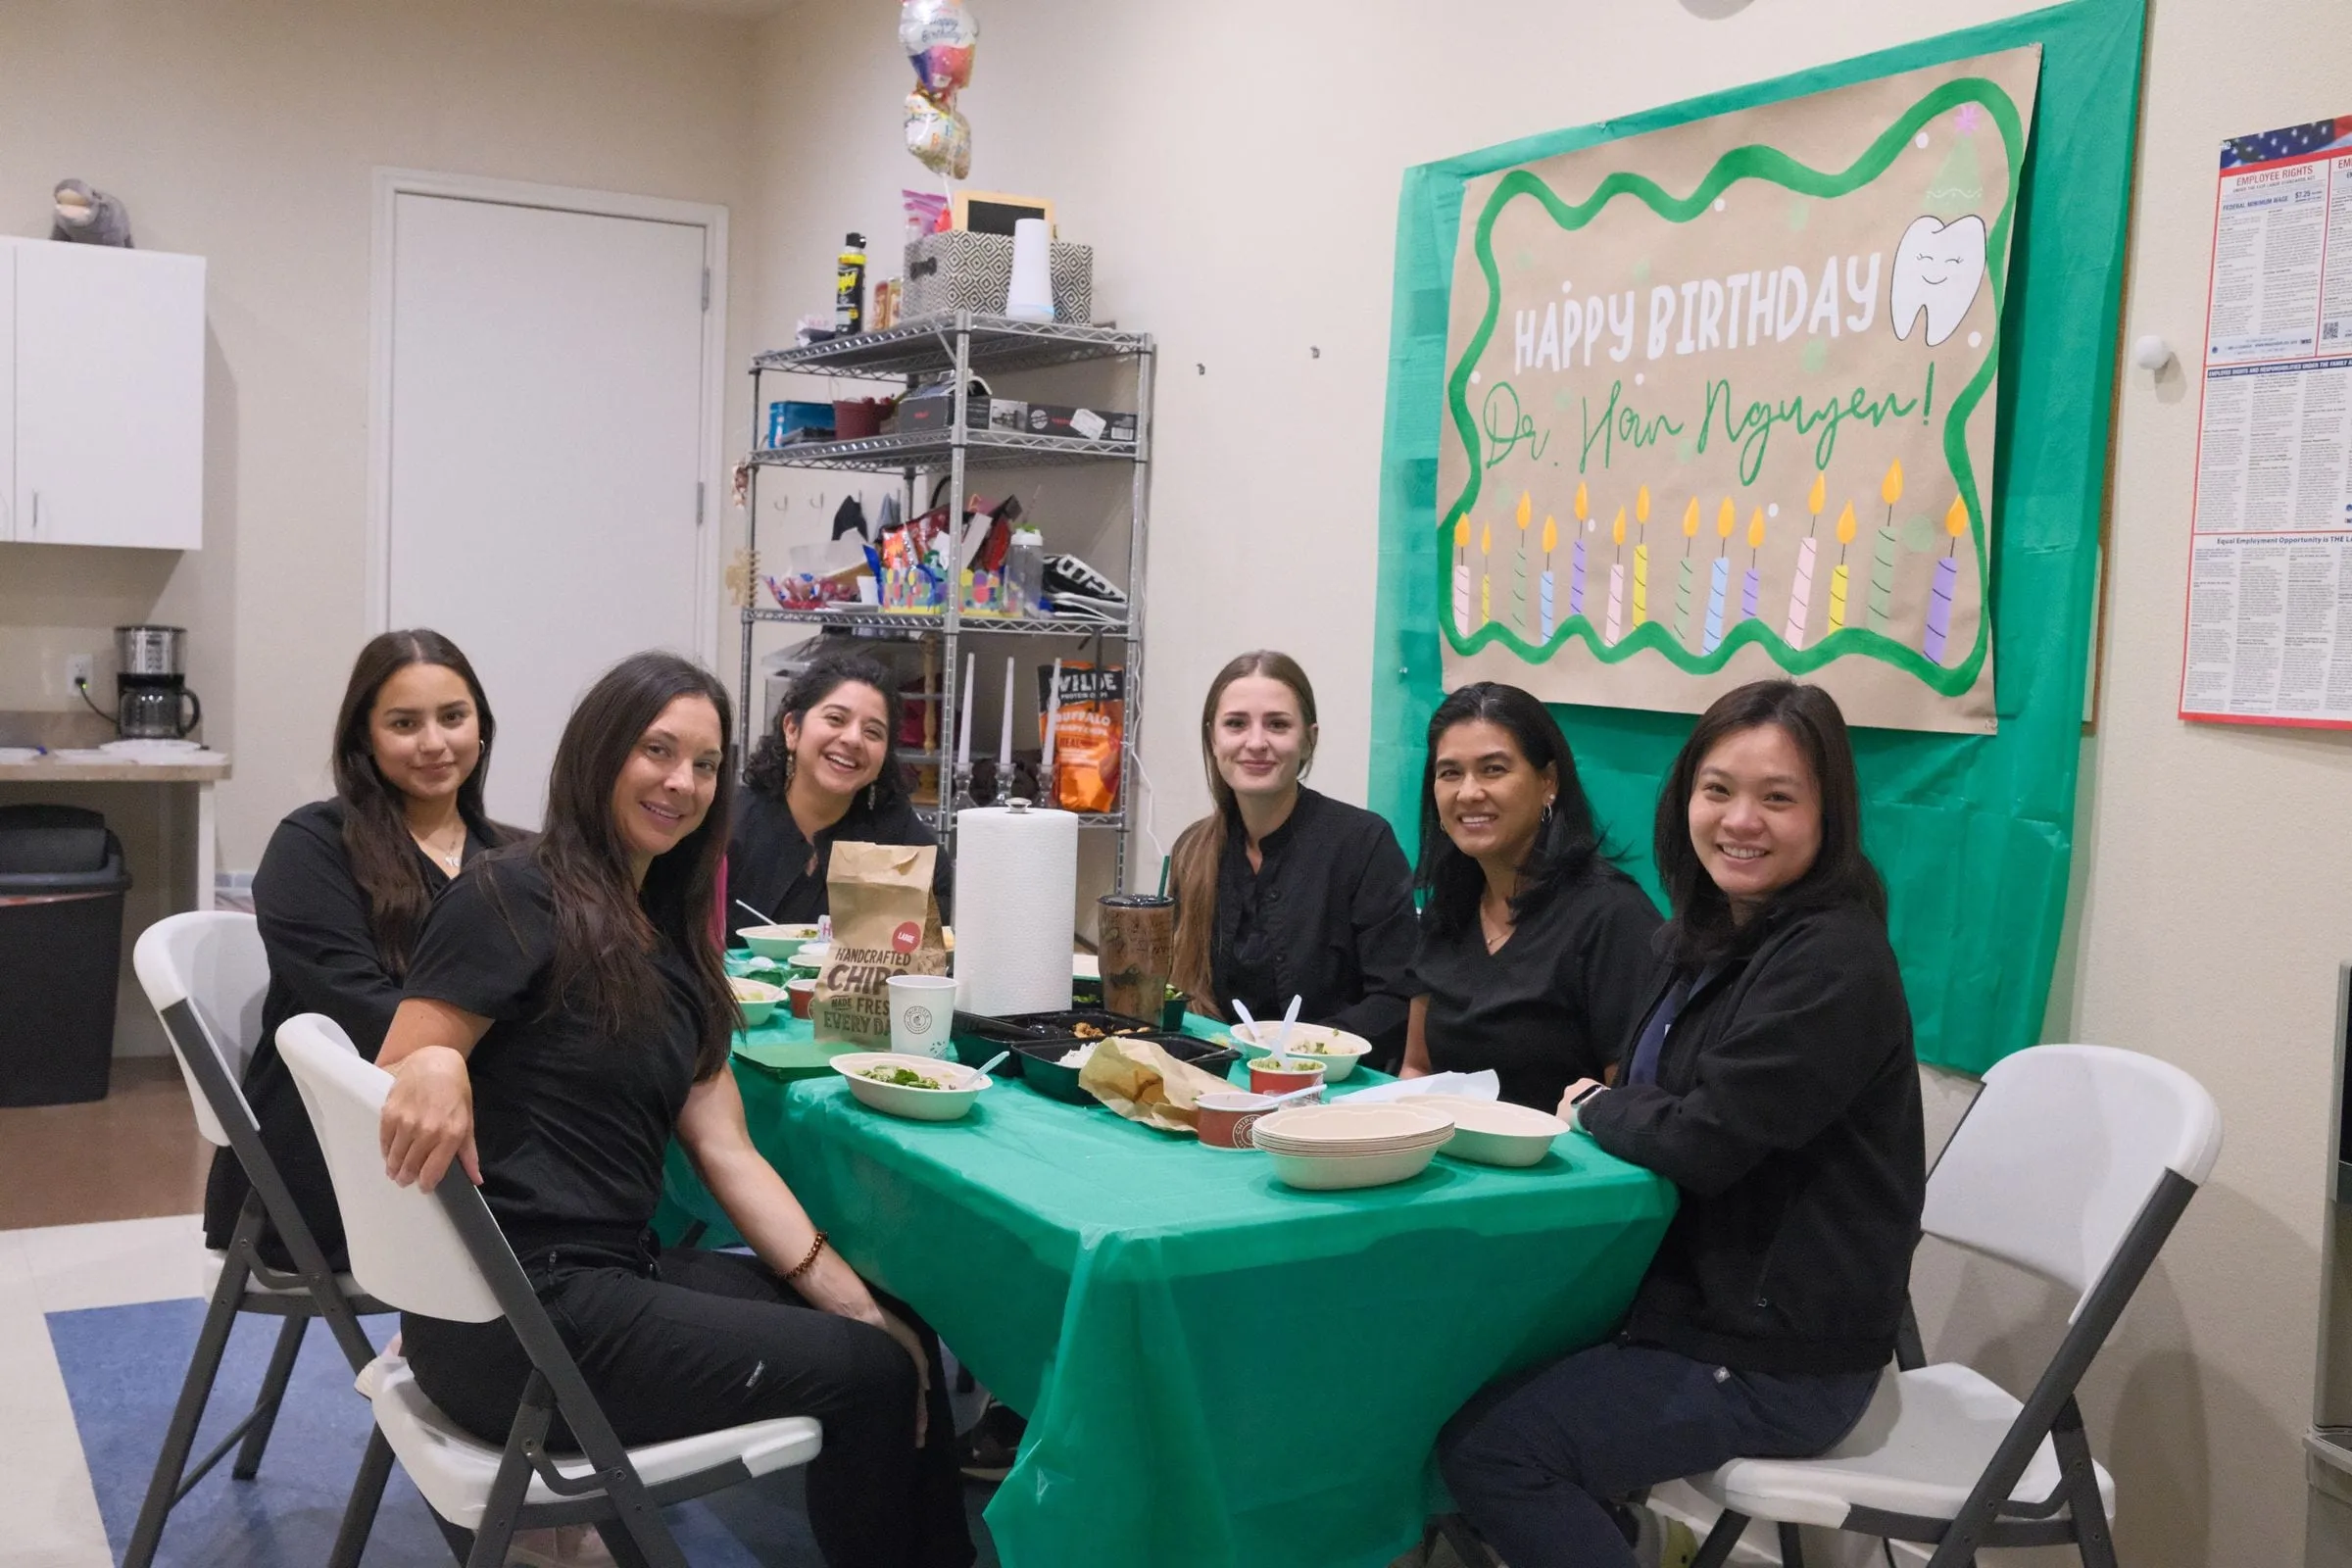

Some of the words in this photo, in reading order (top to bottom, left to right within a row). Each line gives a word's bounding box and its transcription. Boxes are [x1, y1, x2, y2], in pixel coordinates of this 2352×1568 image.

[2236, 171, 2280, 186] EMPLOYEE
[2282, 165, 2314, 178] RIGHTS
[1515, 291, 1635, 375] HAPPY
[1647, 253, 1882, 361] BIRTHDAY
[1484, 381, 1559, 469] Dr.
[1697, 361, 1936, 487] Nguyen!
[2278, 536, 2322, 545] Opportunity
[835, 948, 911, 966] HANDCRAFTED
[831, 998, 852, 1008] MADE
[857, 998, 890, 1016] FRES
[824, 1010, 873, 1035] EVERY
